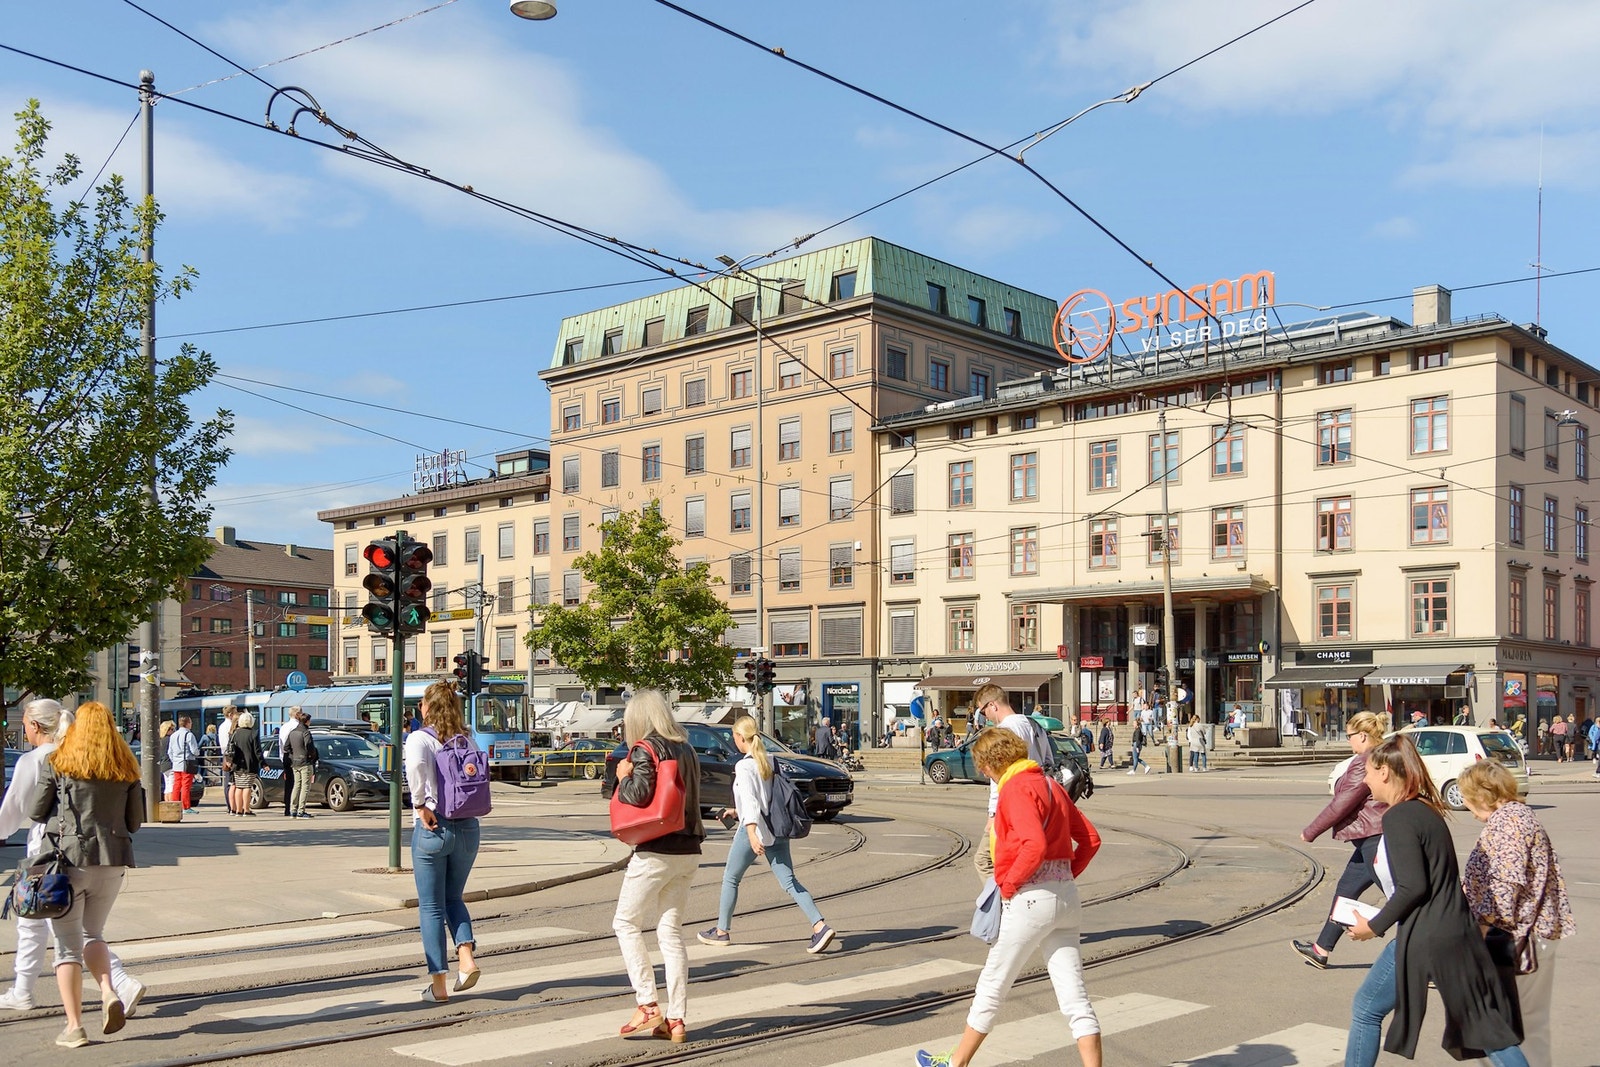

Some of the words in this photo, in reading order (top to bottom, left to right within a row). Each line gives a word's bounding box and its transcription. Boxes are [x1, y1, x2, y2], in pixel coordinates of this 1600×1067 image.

[1121, 269, 1275, 334] SYNSAM
[1141, 335, 1160, 352] VI
[1170, 326, 1212, 346] SER
[1222, 315, 1268, 338] DEG
[415, 448, 467, 472] Hamilton
[1316, 651, 1351, 659] CHANGE
[985, 660, 1022, 672] SAMSON
[291, 674, 302, 684] 10
[827, 687, 852, 695] Nordea
